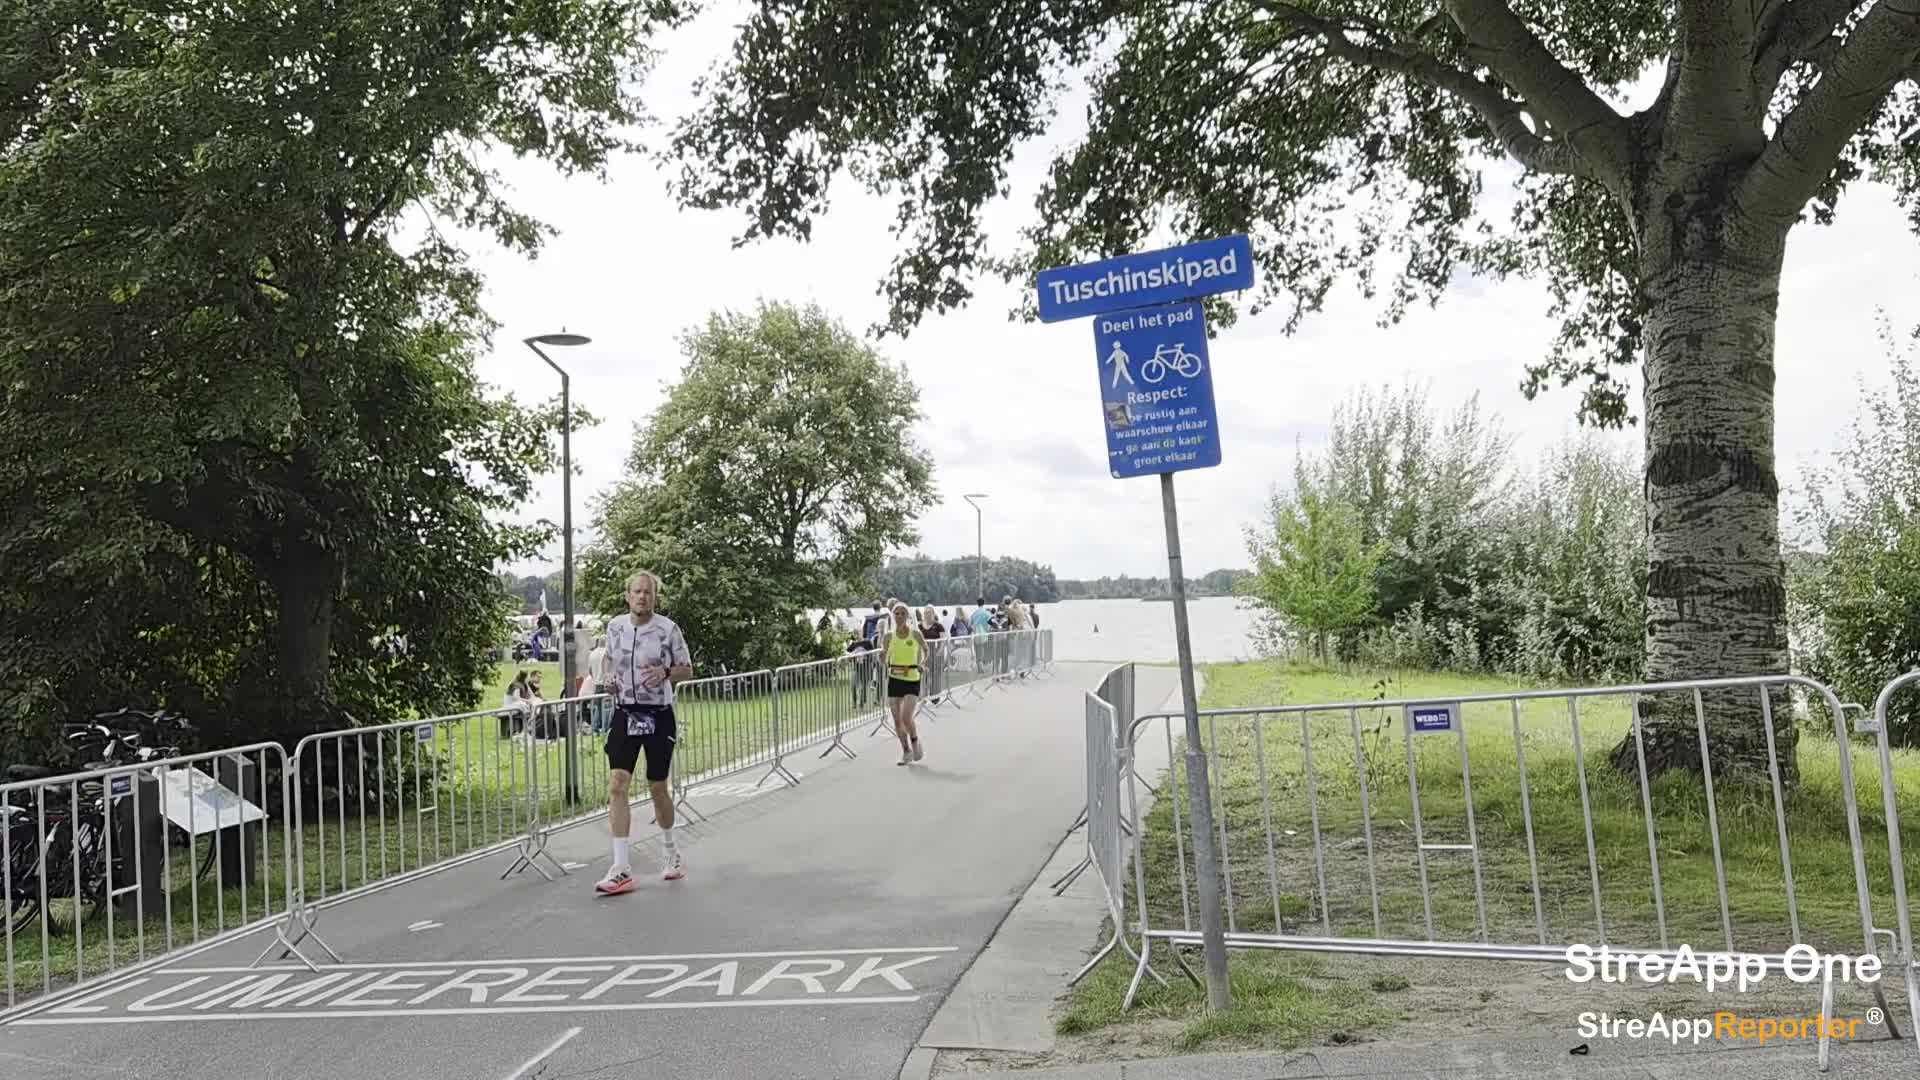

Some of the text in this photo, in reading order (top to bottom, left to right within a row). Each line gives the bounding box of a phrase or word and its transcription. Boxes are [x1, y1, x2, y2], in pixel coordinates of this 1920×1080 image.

[1048, 248, 1238, 304] Tuschinskipad
[1102, 307, 1194, 334] Deel het pad
[1127, 386, 1188, 404] Respect:
[1145, 408, 1176, 420] rustig
[1179, 406, 1198, 416] aan
[1115, 419, 1208, 439] waarschuw elkaar
[1133, 451, 1197, 469] groet elkaar
[47, 956, 942, 1013] LUMIEREPARK
